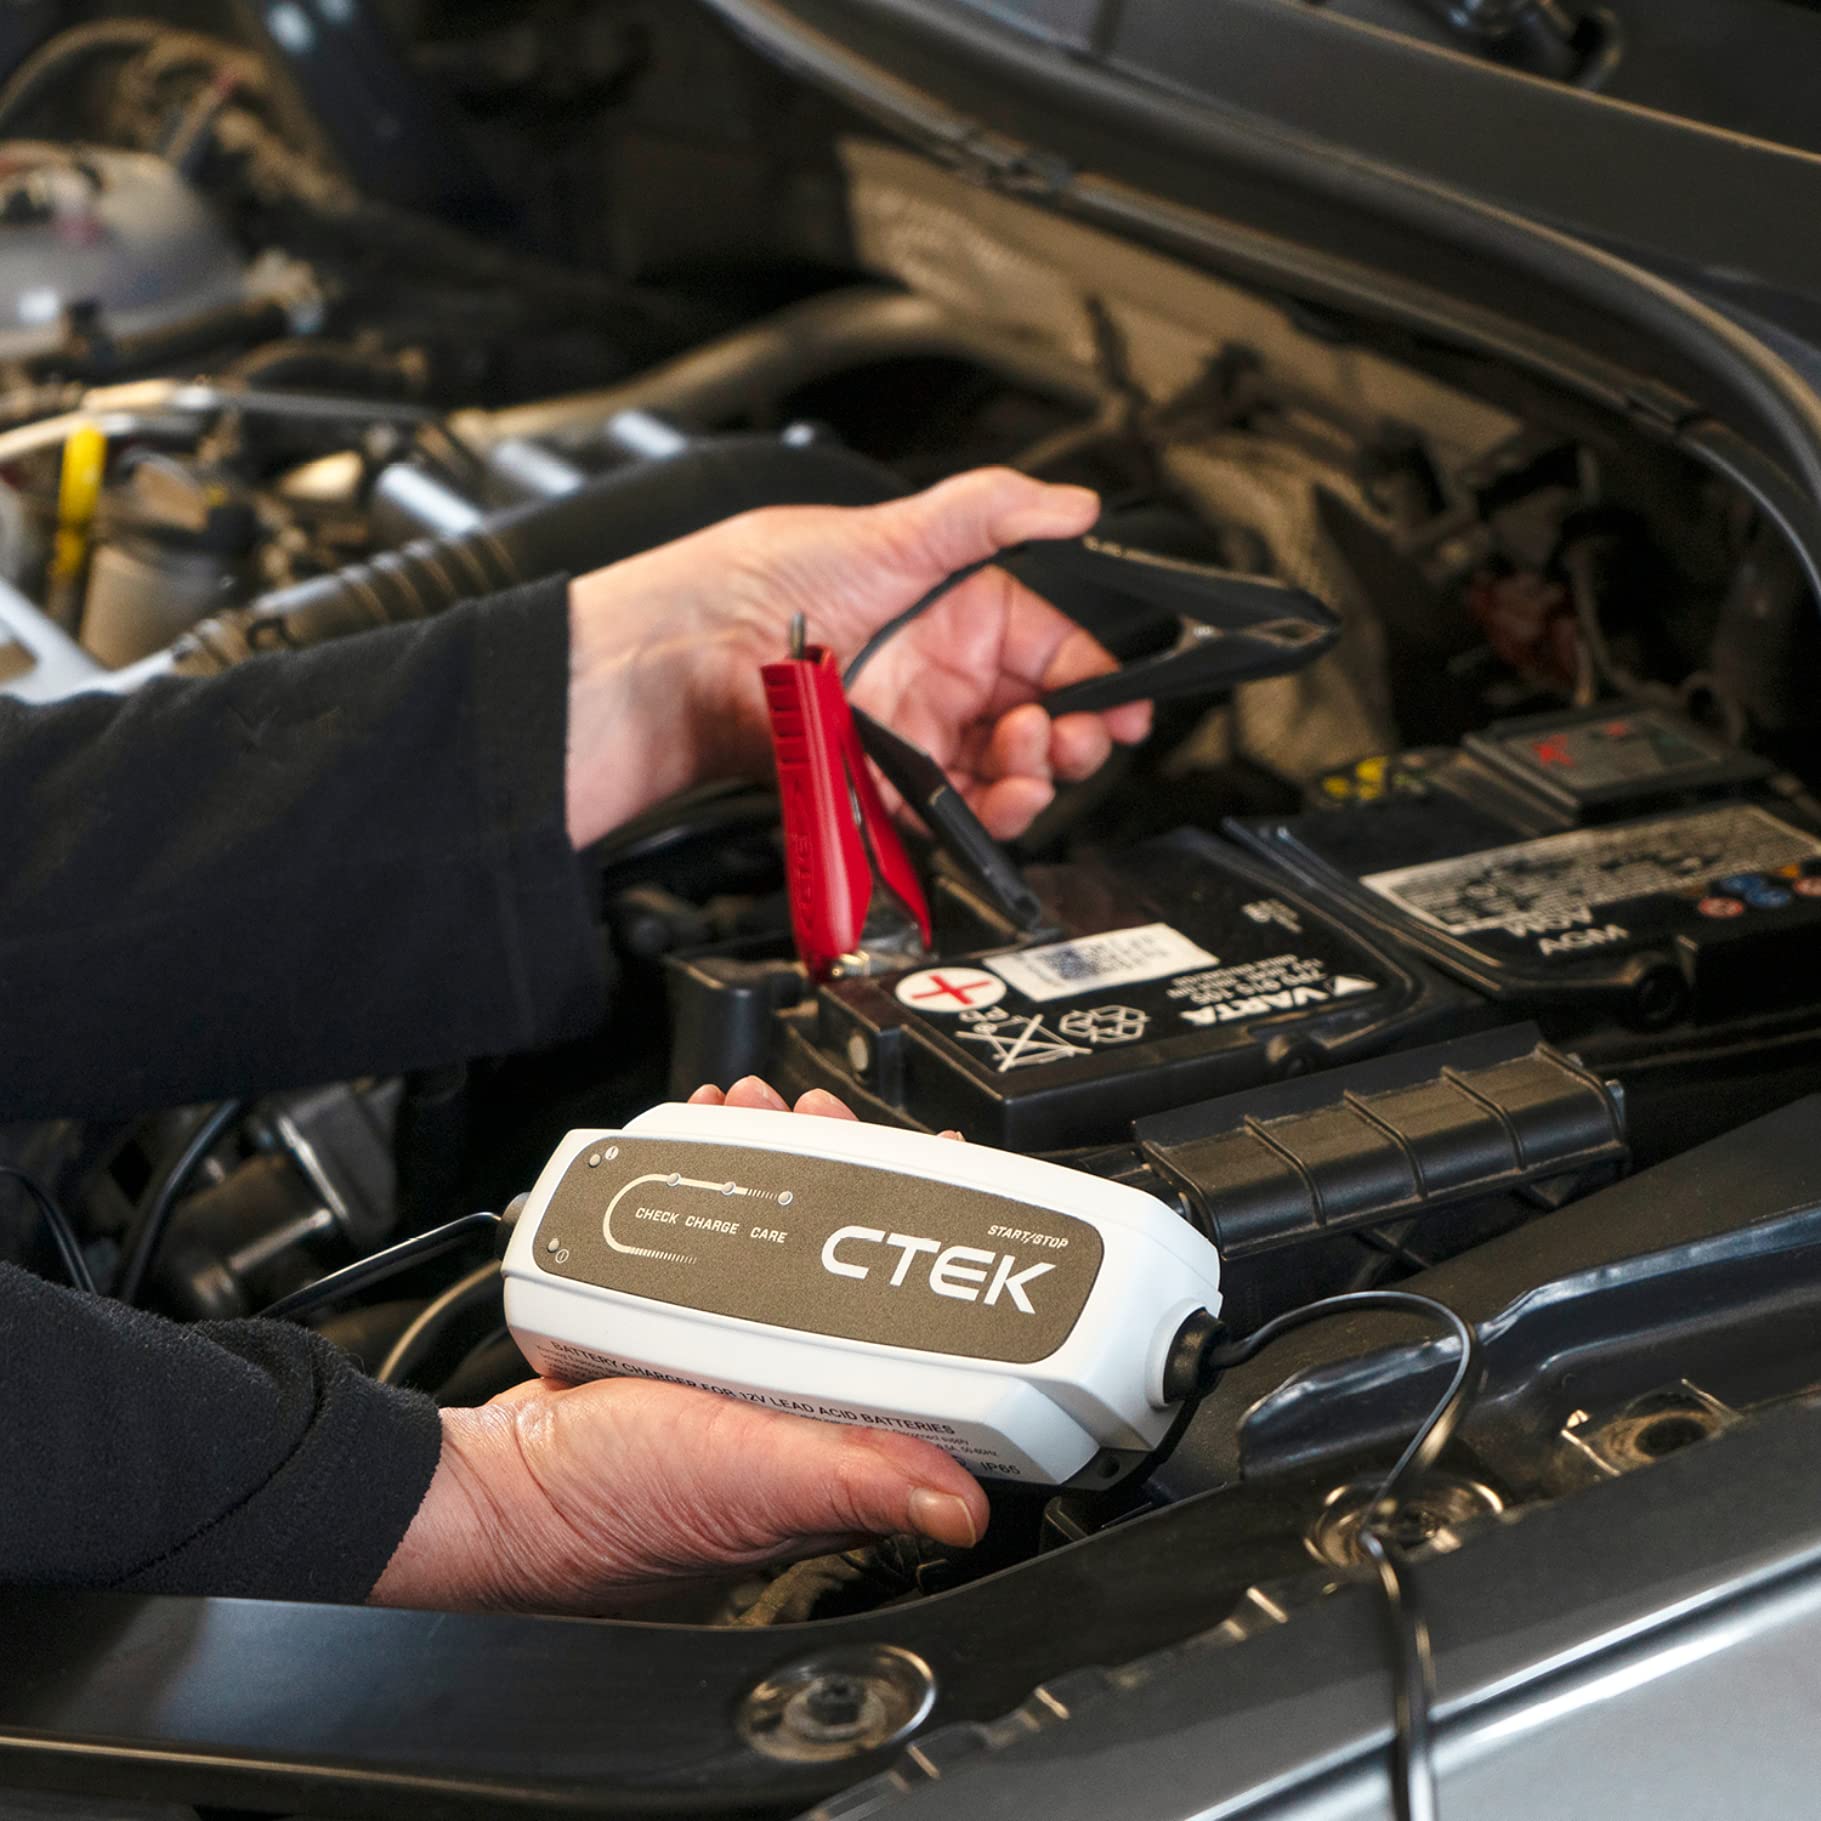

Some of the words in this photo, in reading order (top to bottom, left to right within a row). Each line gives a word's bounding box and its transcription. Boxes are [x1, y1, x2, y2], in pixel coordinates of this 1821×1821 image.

[1179, 986, 1330, 1026] VARTA
[635, 1207, 680, 1225] CHECK
[684, 1215, 740, 1235] CHARGE
[750, 1226, 788, 1244] CARE
[987, 1224, 1070, 1250] START/STOP
[821, 1225, 1057, 1315] CTEK
[550, 1340, 618, 1369] BATTERY
[622, 1362, 697, 1388] CHARGER
[700, 1382, 737, 1398] FOR
[738, 1391, 766, 1404] 12V
[769, 1397, 815, 1413] LEAD
[818, 1406, 858, 1421] ACID
[860, 1413, 956, 1435] BATTERIES
[979, 1461, 1022, 1475] IP65
